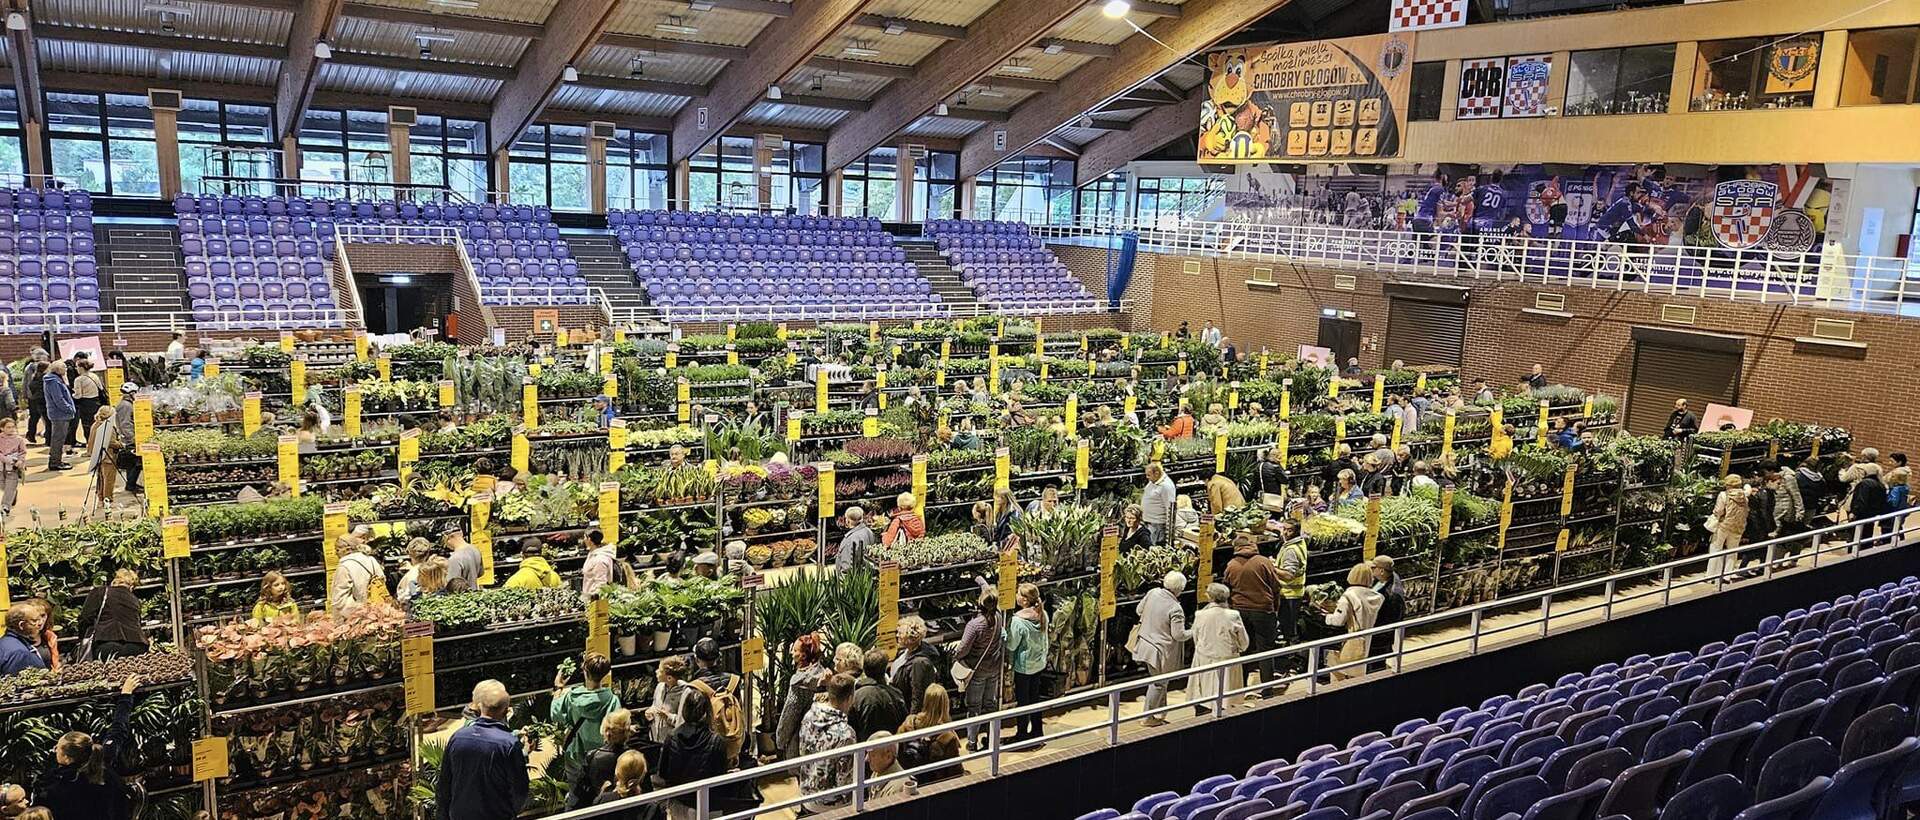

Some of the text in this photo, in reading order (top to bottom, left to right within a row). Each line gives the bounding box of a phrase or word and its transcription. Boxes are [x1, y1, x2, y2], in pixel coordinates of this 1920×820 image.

[1298, 40, 1328, 57] wielu
[1254, 70, 1300, 89] CHROBRY
[1303, 65, 1348, 86] GŁOGÓW
[1461, 67, 1502, 98] CHR
[700, 111, 705, 125] D
[997, 134, 1003, 146] E
[1482, 192, 1501, 209] 20
